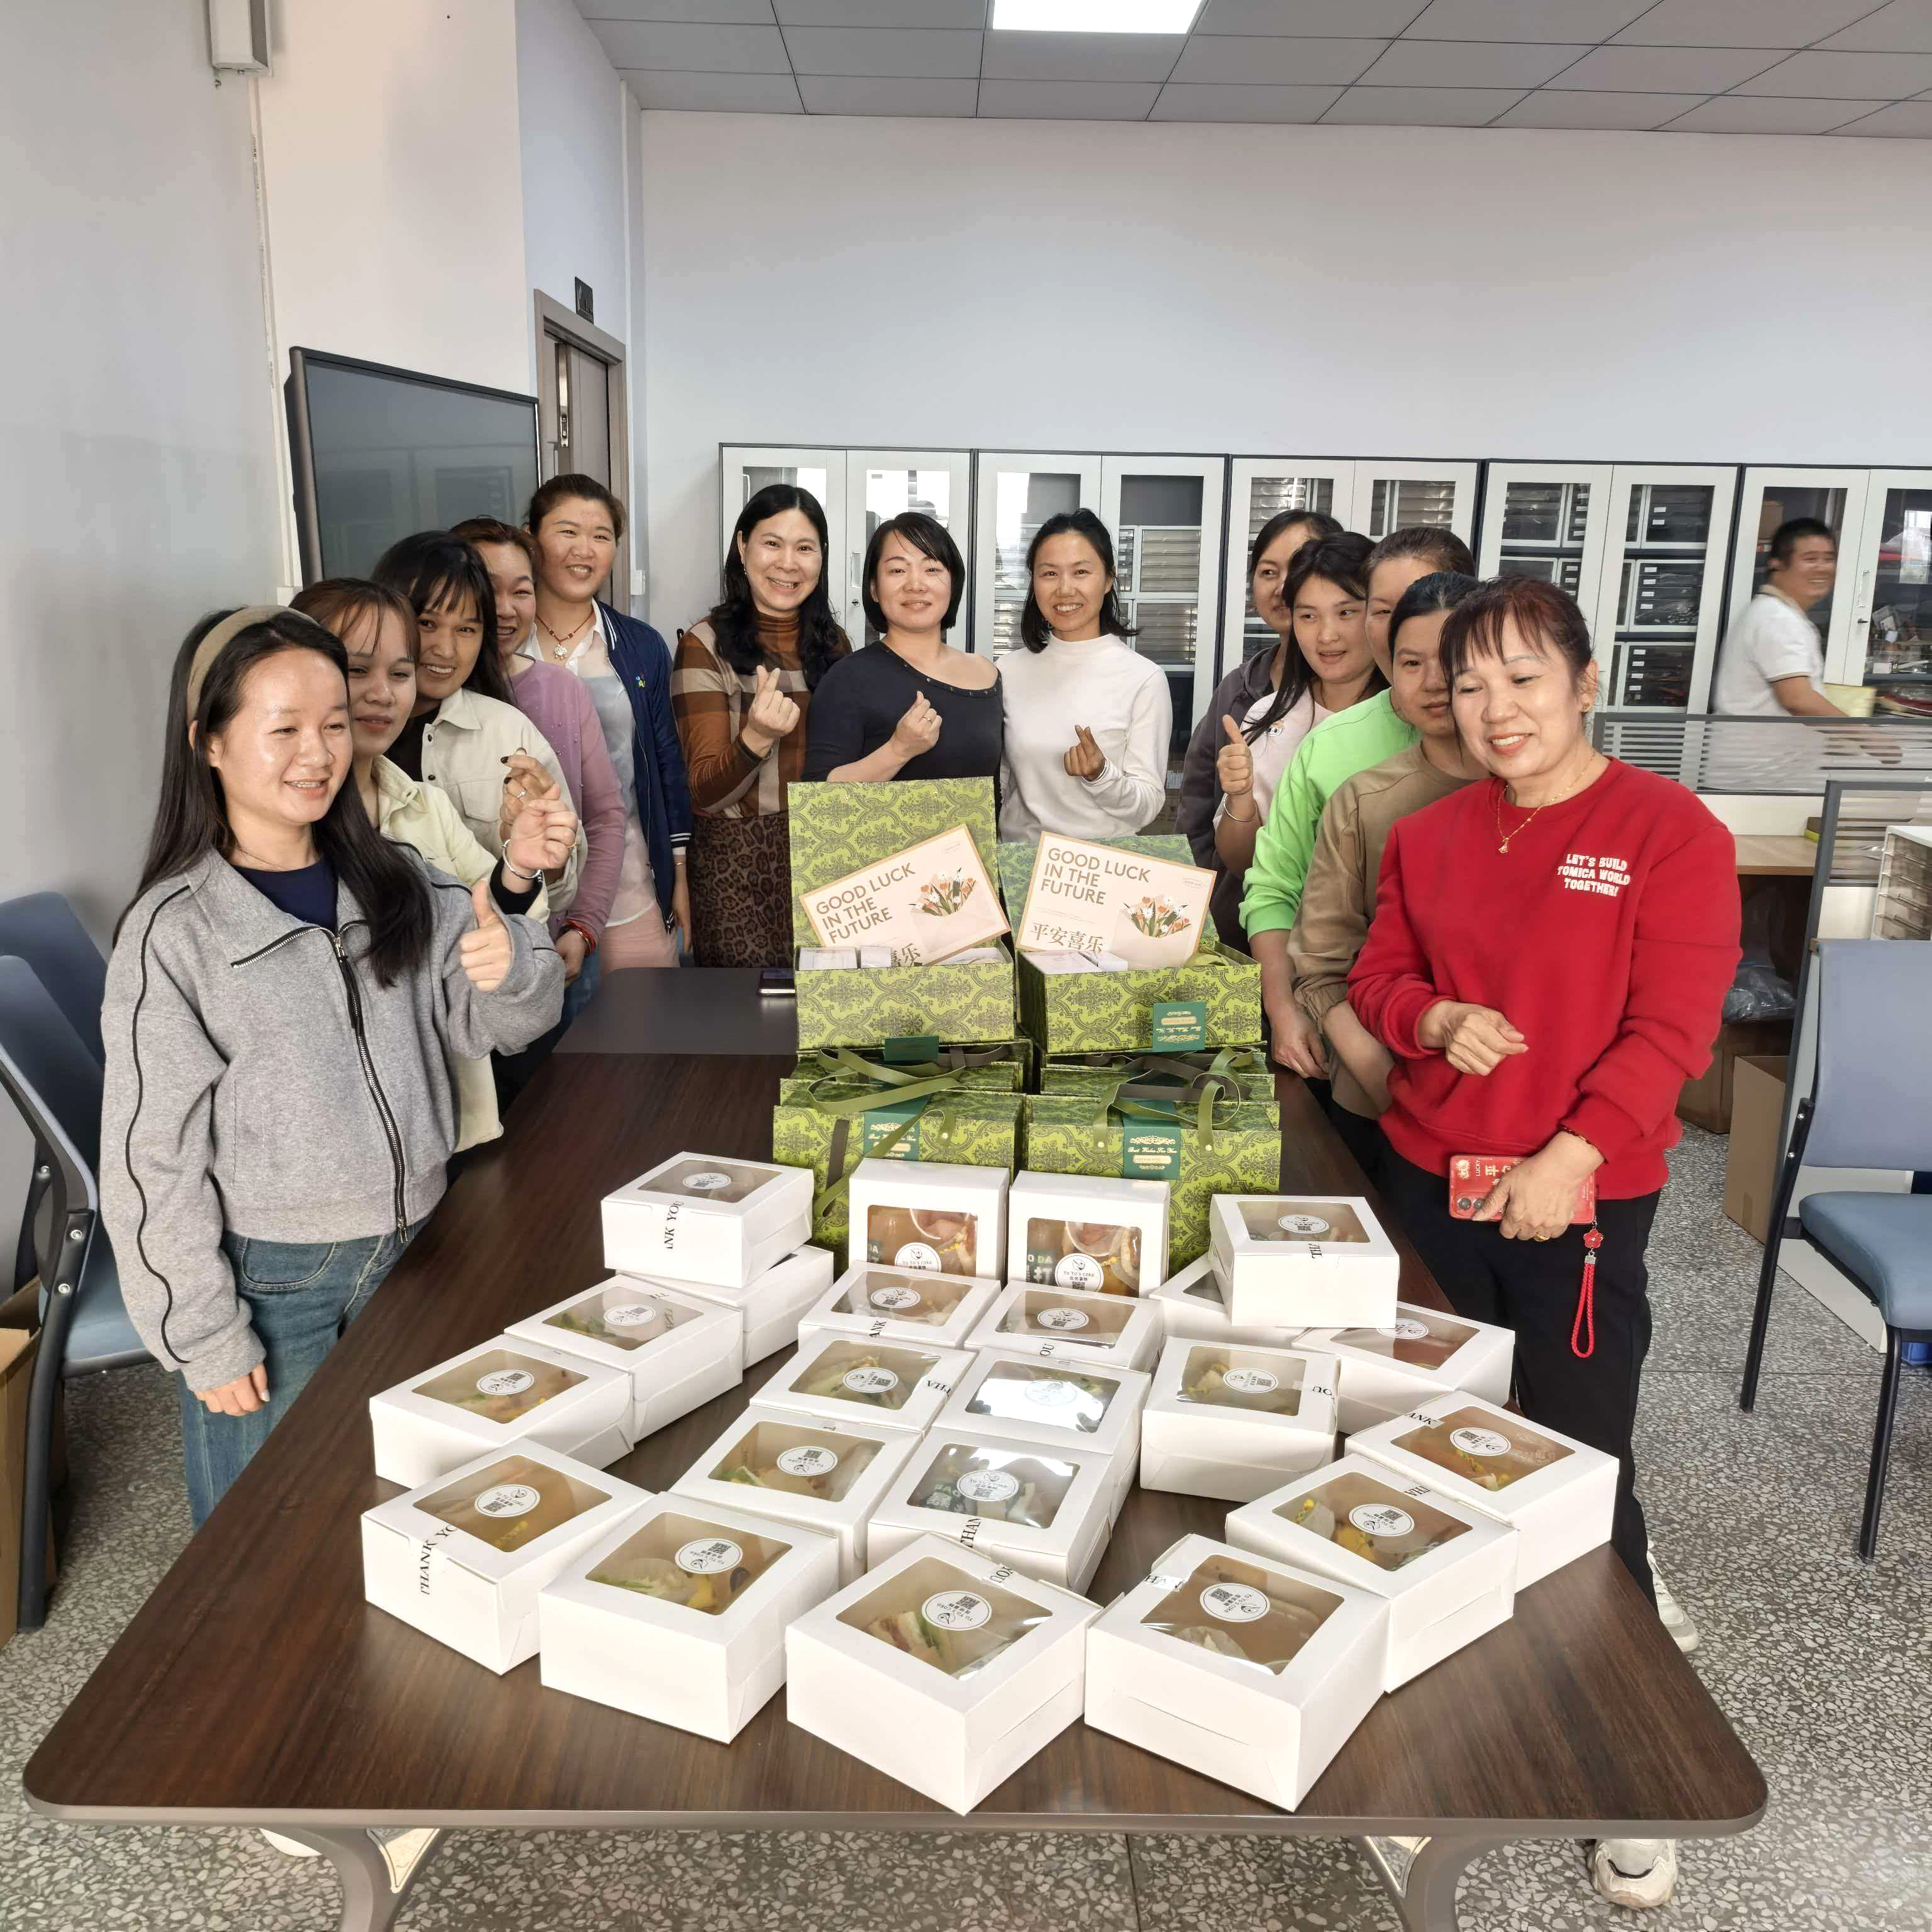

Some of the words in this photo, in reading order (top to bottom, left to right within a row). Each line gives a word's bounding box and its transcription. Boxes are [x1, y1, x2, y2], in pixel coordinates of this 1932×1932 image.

[1044, 863, 1063, 879] IN
[1069, 868, 1101, 887] THE
[1048, 848, 1101, 870] GOOD
[1105, 860, 1152, 882] LUCK
[1557, 865, 1596, 879] TOMICA
[1599, 869, 1631, 886] WORLD
[1565, 853, 1597, 867] LET'S
[1598, 857, 1628, 872] BUILD
[816, 885, 867, 914] GOOD
[869, 862, 916, 892] LUCK
[1041, 879, 1107, 906] FUTURE
[1564, 877, 1619, 897] TOGETHER!
[822, 914, 842, 930] IN
[843, 897, 878, 921] THE
[829, 907, 893, 944] FUTURE
[1030, 922, 1104, 953] 平安喜乐
[667, 1201, 684, 1221] YOU
